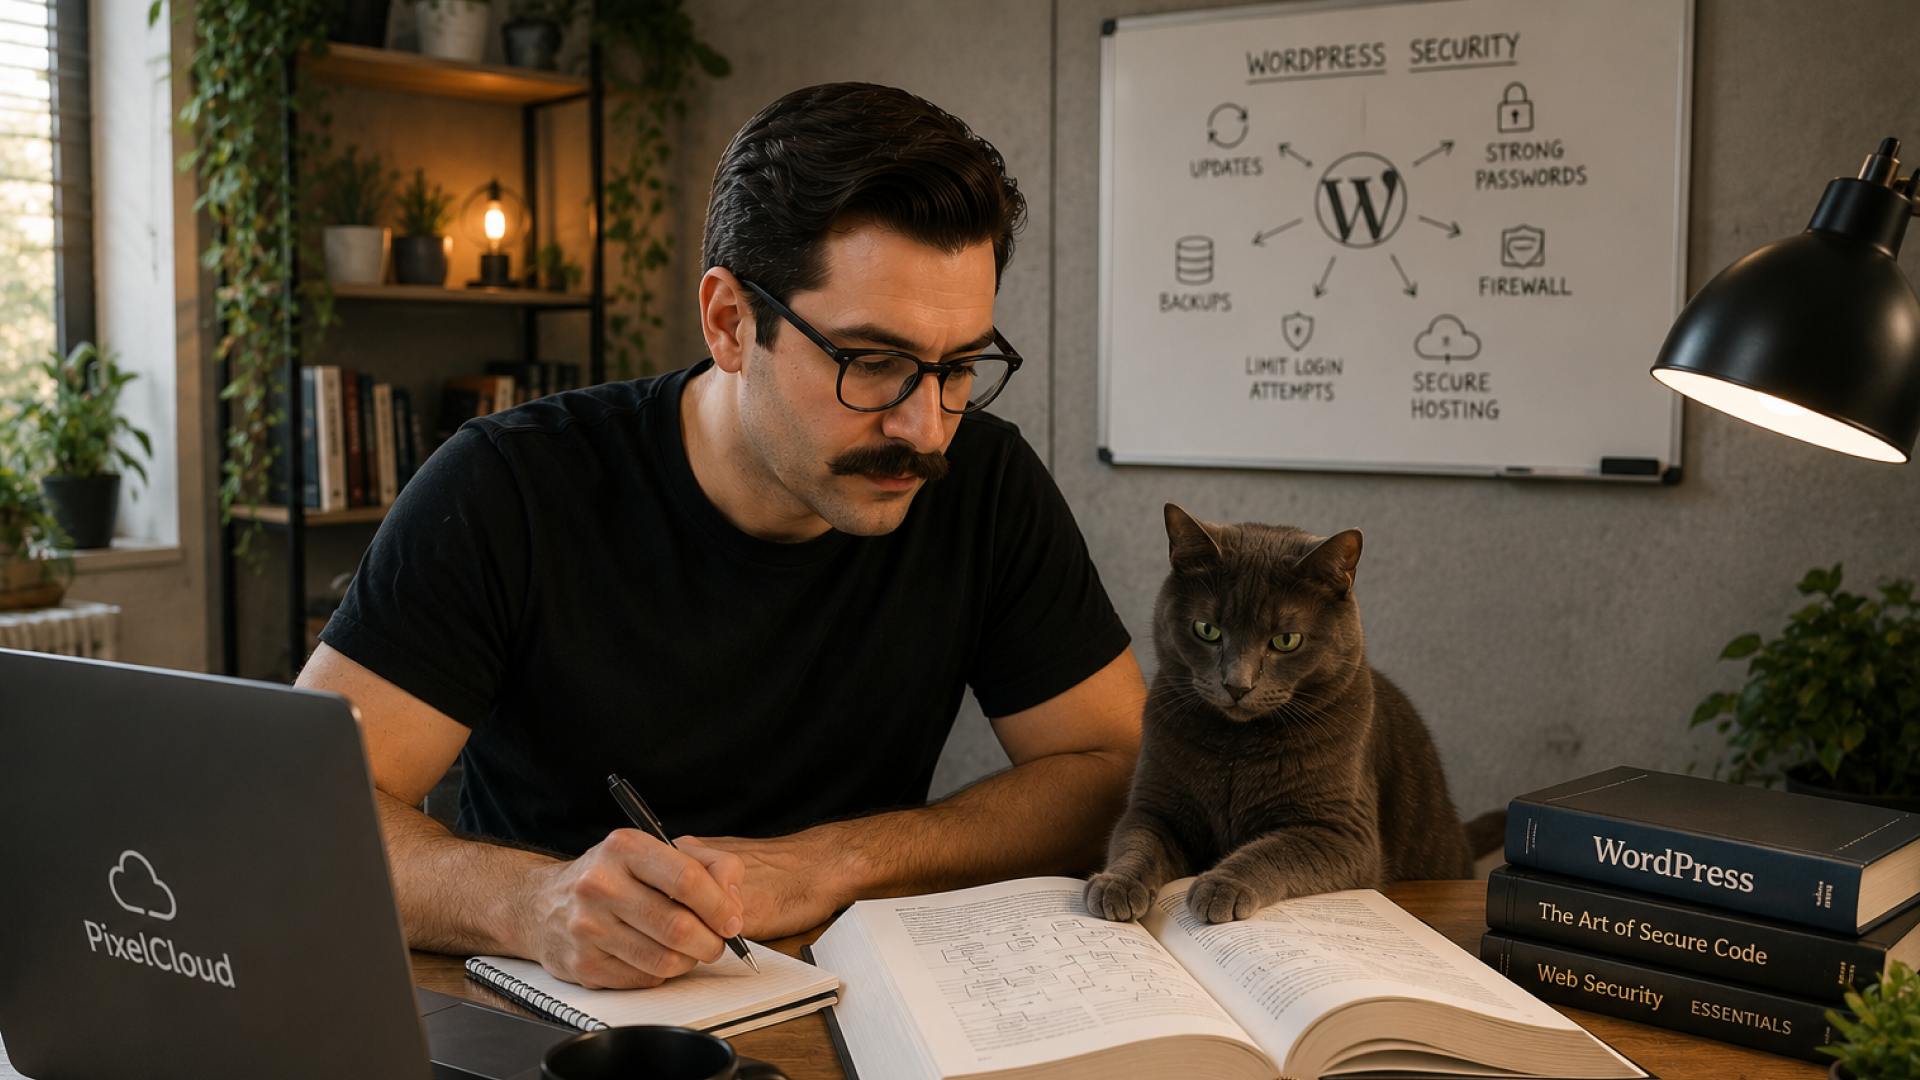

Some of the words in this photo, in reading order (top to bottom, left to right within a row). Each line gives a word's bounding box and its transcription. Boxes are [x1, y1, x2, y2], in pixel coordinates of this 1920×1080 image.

[1246, 42, 1386, 77] WORDPRESS
[1409, 33, 1521, 65] SECURITY
[1485, 140, 1565, 163] STRONG
[1190, 157, 1264, 179] UPDATES
[1475, 165, 1588, 190] PASSWORDS
[1321, 170, 1399, 243] W
[1478, 276, 1573, 297] FIREWALL
[1159, 293, 1232, 312] BACKUPS
[1245, 357, 1287, 376] LIMIT
[1294, 357, 1344, 377] LOGIN
[1249, 382, 1335, 402] ATTEMPTS
[1413, 371, 1491, 393] SECURE
[1411, 398, 1500, 421] HOSTING
[1592, 835, 1756, 893] WordPress
[1538, 901, 1574, 926] The
[1578, 910, 1610, 934] Art
[1614, 917, 1637, 939] of
[1639, 922, 1708, 953] Secure
[1714, 938, 1769, 966] Code
[83, 918, 236, 989] PixelCloud
[1537, 963, 1579, 989] Web
[1583, 973, 1665, 1011] Security
[1691, 1000, 1792, 1036] ESSENTIALS
